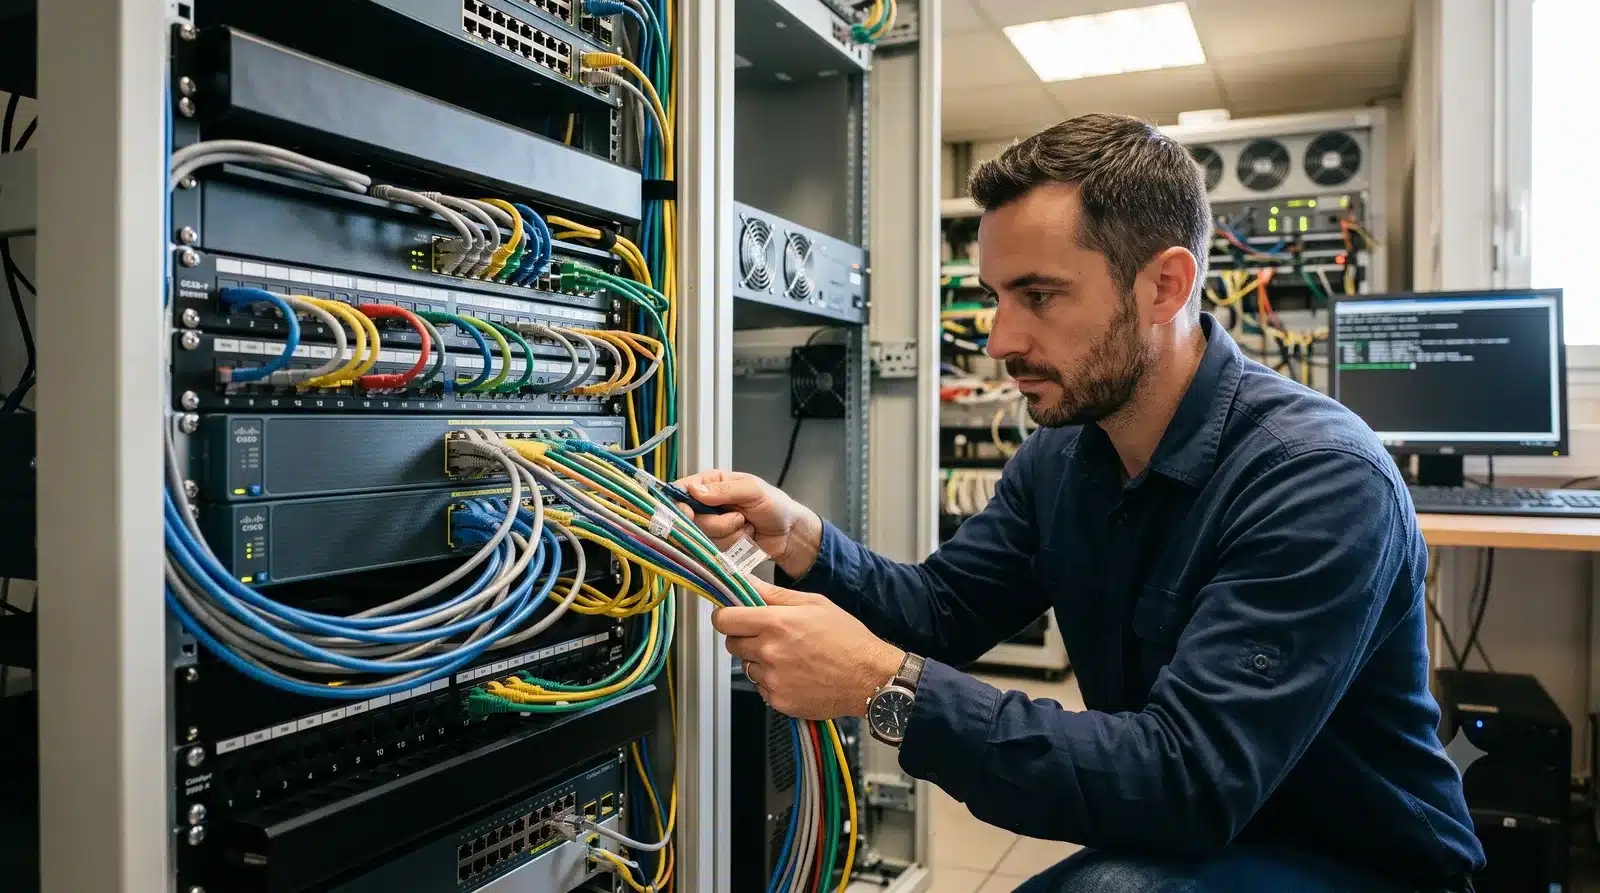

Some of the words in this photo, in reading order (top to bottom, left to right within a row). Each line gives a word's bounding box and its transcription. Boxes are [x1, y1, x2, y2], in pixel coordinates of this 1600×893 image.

[228, 799, 233, 807] 1
[256, 790, 261, 798] 2
[282, 780, 288, 789] 3
[332, 764, 337, 772] 5
[376, 748, 384, 756] 10
[397, 741, 406, 749] 10
[438, 727, 445, 735] 12
